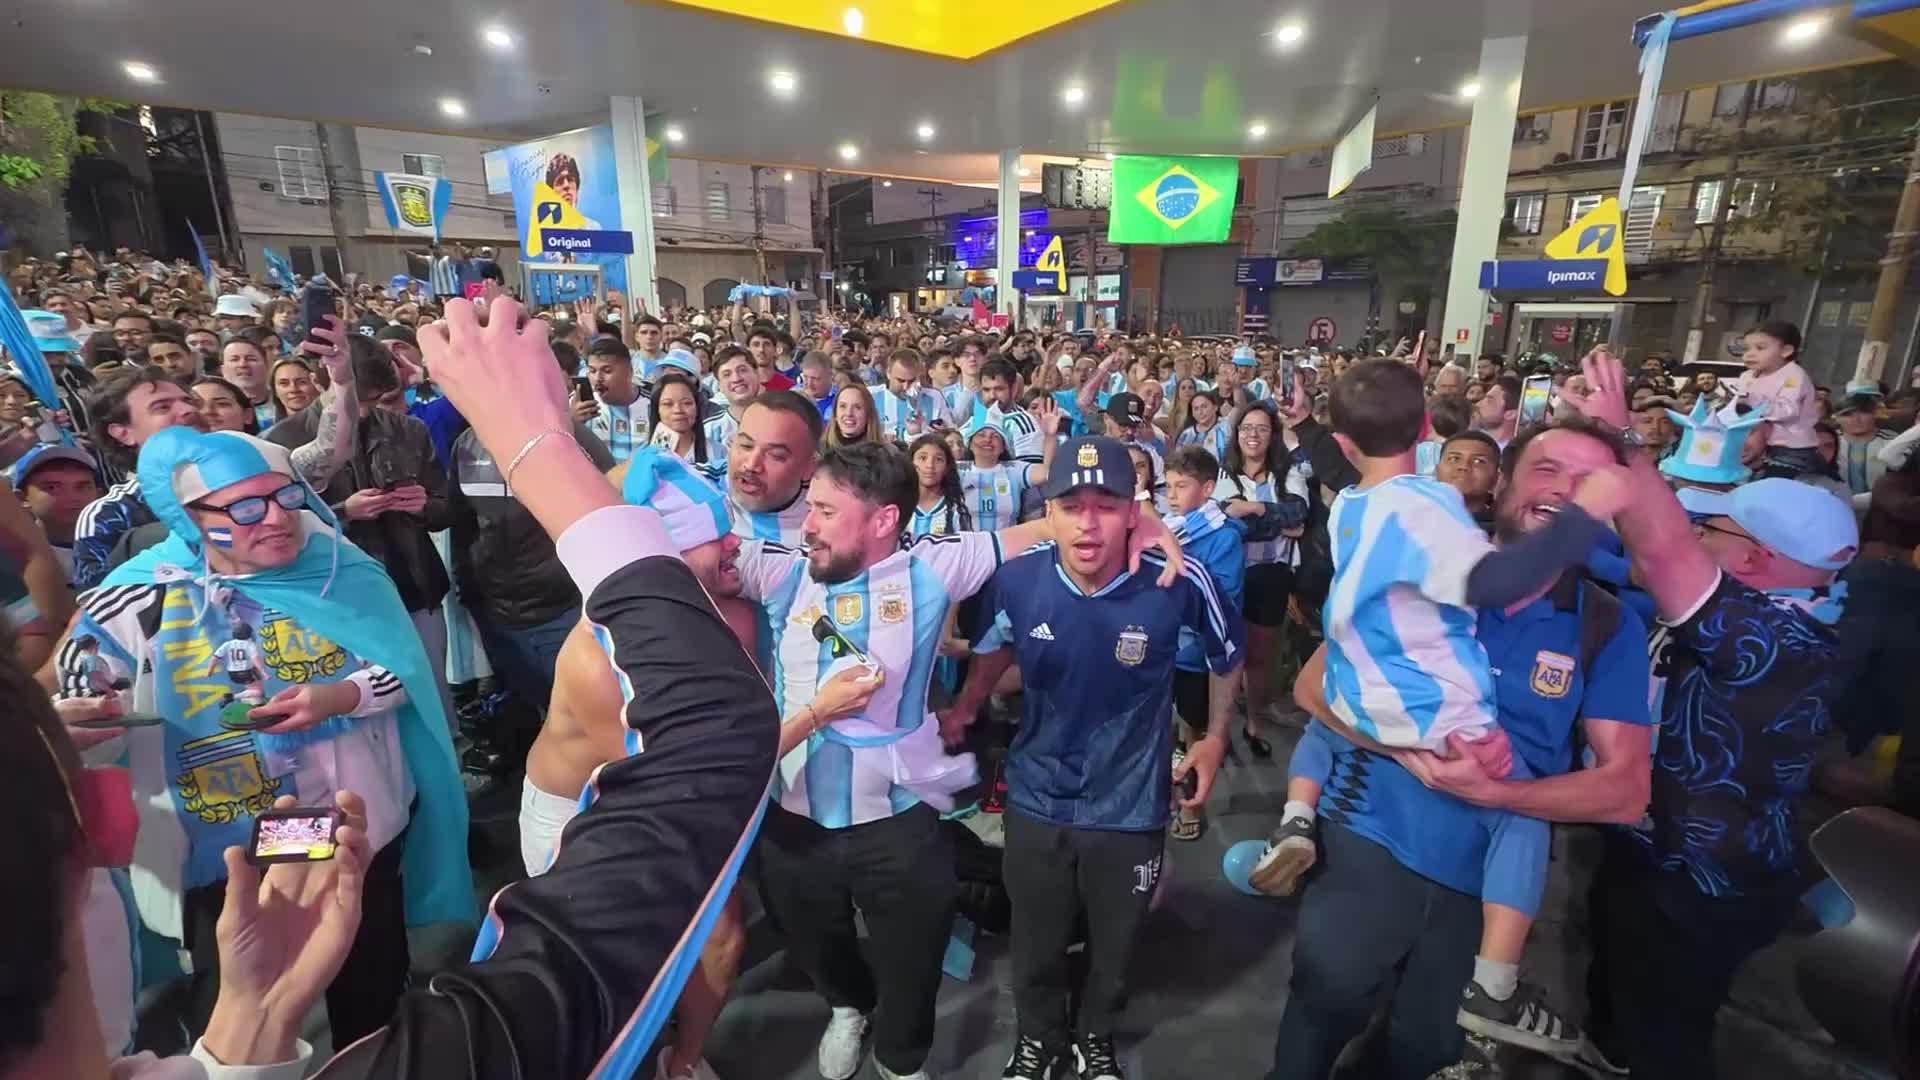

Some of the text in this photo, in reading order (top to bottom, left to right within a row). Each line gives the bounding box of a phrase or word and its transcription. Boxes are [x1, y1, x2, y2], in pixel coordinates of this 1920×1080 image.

[548, 236, 592, 250] Original
[1547, 270, 1597, 285] Ipimax
[982, 499, 994, 512] 10
[231, 648, 247, 661] 10
